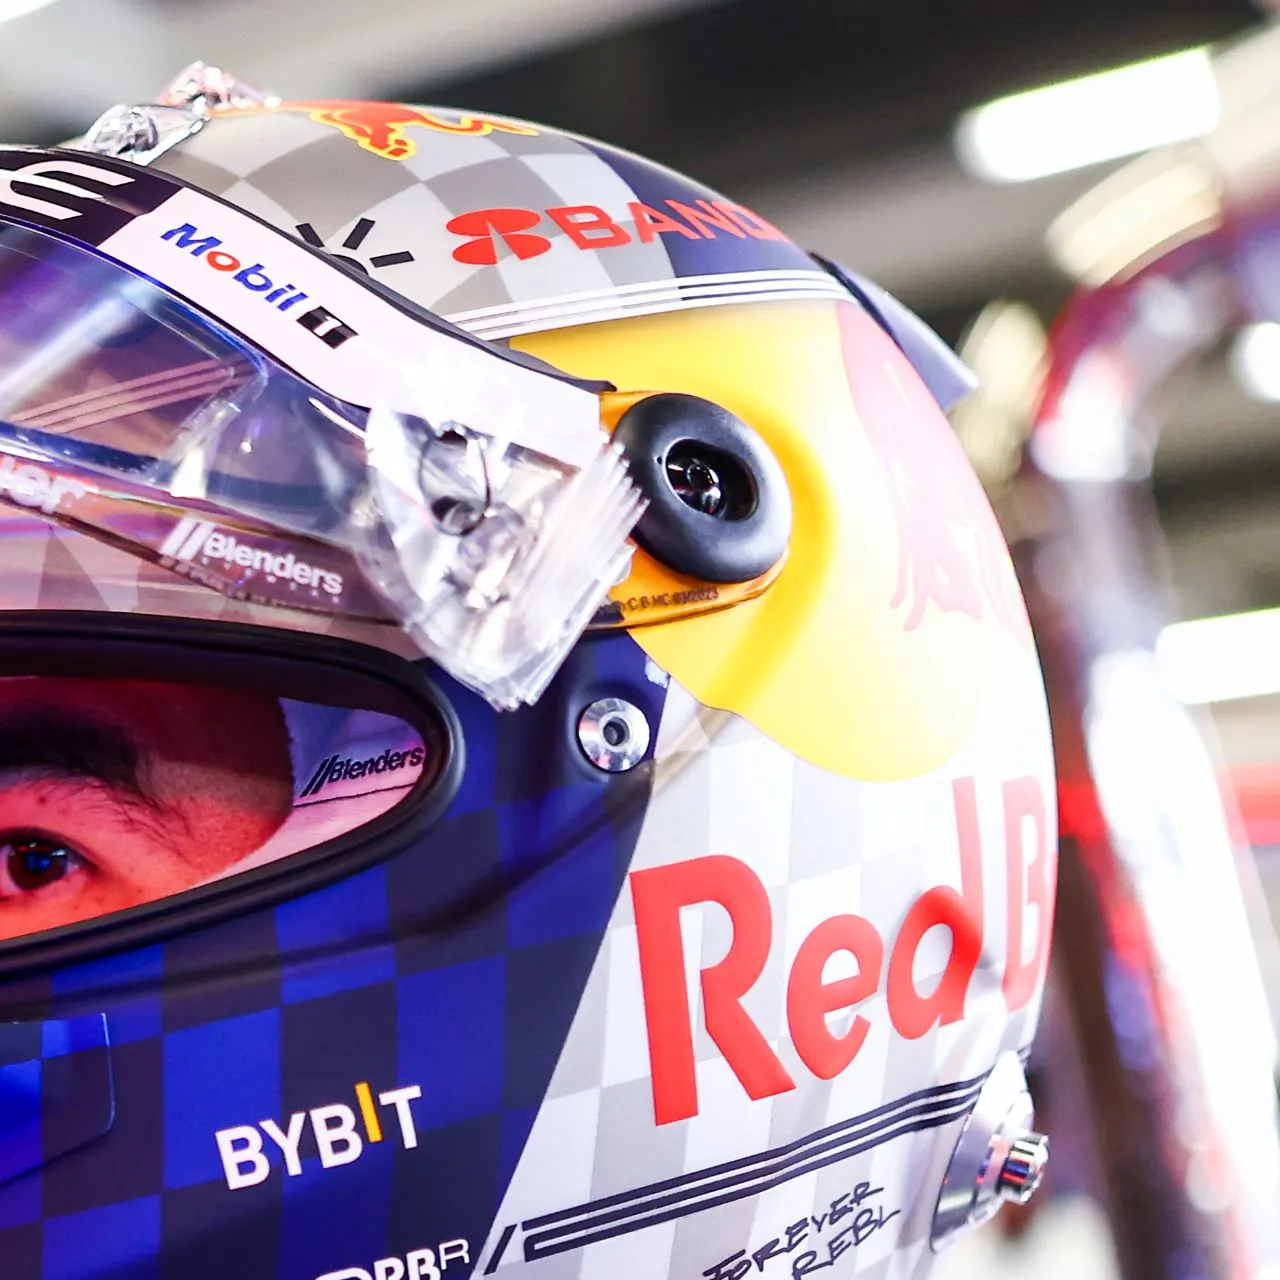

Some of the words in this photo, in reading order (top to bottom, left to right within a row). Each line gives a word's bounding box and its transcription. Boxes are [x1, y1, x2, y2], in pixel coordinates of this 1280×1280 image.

[160, 223, 309, 312] Mobil
[629, 775, 984, 1127] Red
[215, 1081, 422, 1190] BYBIT
